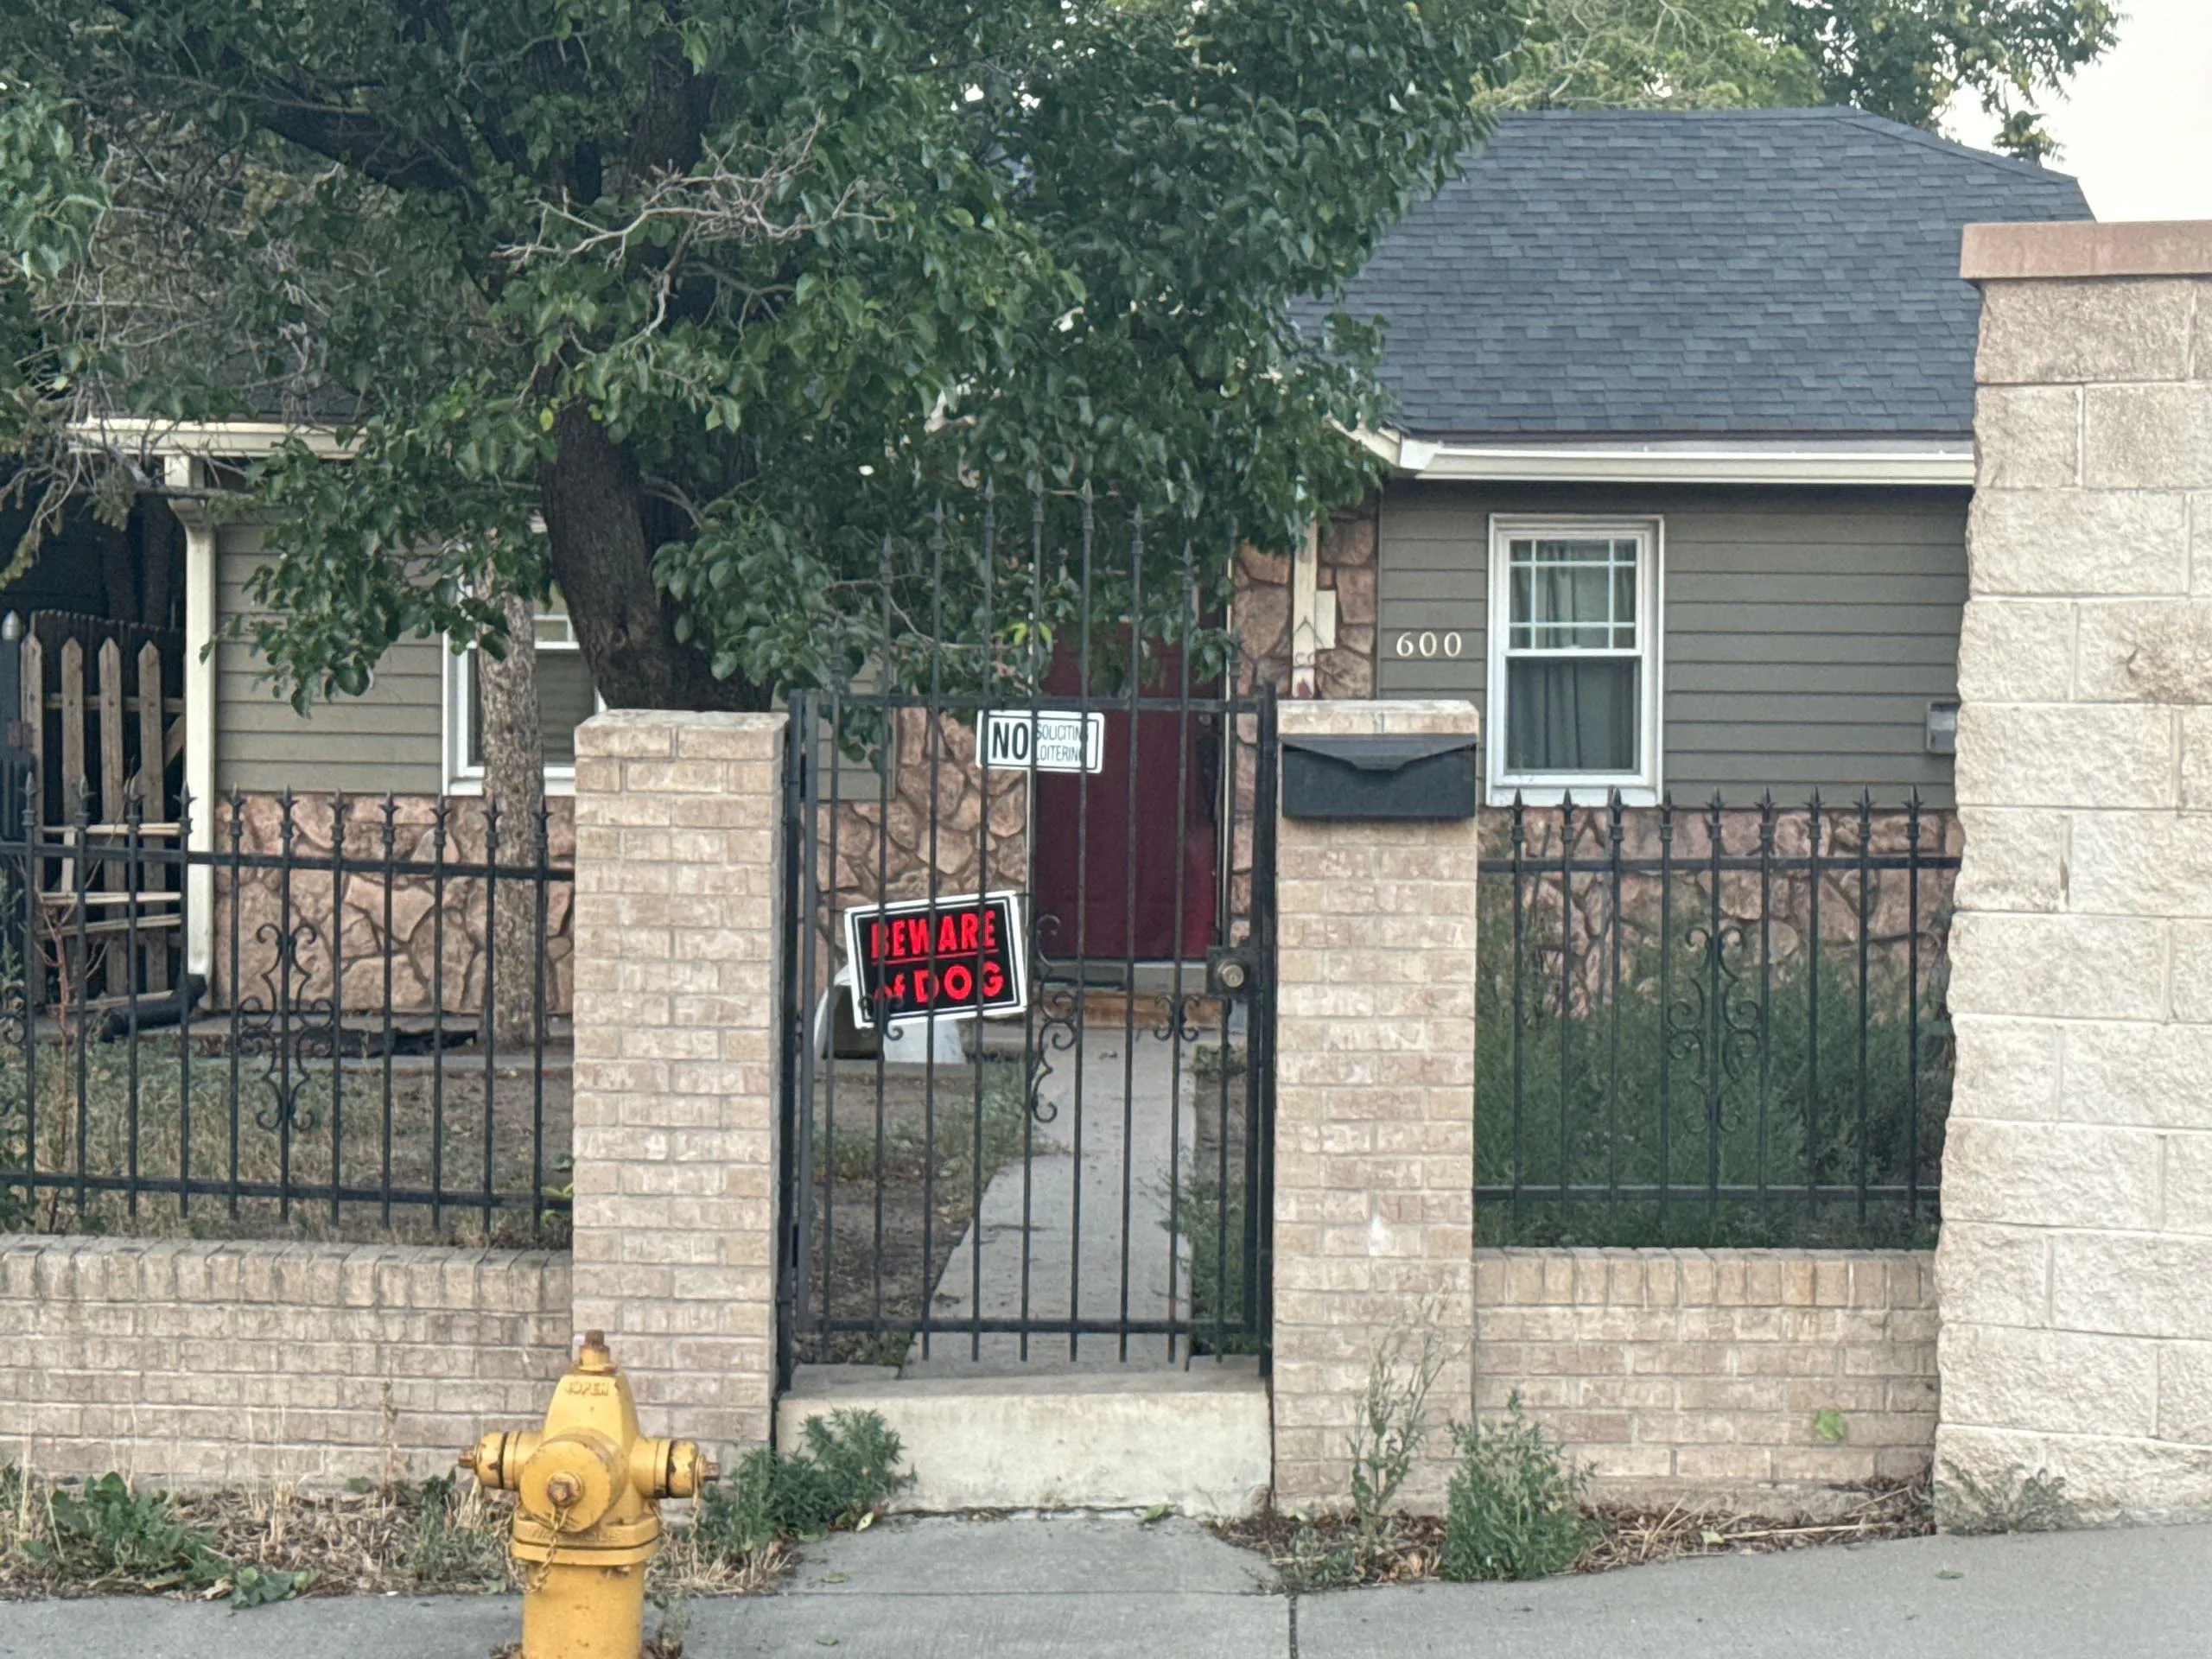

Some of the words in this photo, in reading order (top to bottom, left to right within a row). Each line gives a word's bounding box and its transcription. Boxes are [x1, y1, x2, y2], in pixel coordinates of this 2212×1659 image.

[1396, 632, 1462, 658] 600
[992, 721, 1029, 760] NO
[1036, 723, 1087, 741] SOLICITIN
[1036, 744, 1085, 762] OITERIN
[871, 910, 997, 959] BEWARE
[913, 961, 1004, 1003] DOG
